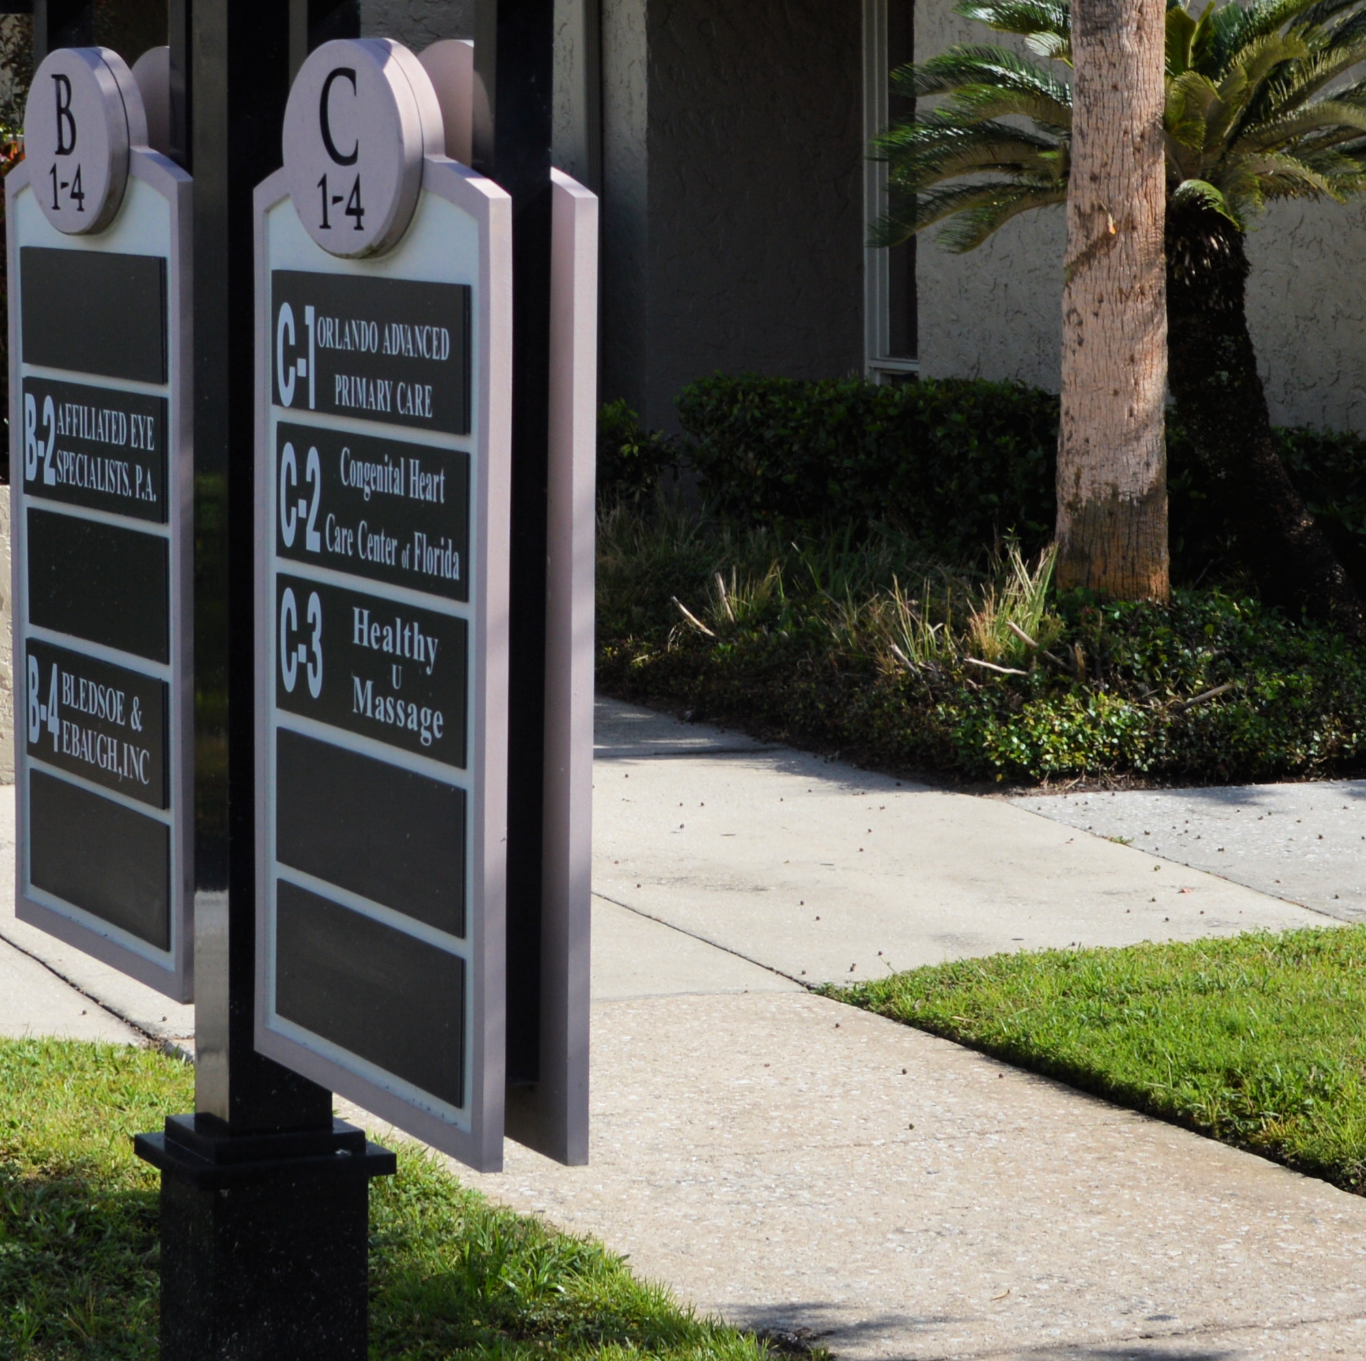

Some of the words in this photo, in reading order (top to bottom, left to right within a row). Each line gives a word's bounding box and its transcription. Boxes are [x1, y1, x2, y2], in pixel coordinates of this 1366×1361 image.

[51, 74, 77, 156] B
[320, 67, 359, 167] C
[48, 163, 85, 212] 1-4
[317, 173, 365, 231] 1-4
[277, 302, 315, 410] C-1
[317, 316, 378, 353] ORLANDO
[383, 323, 450, 360] ADVANCED
[56, 403, 127, 446] AFFILIATED
[130, 413, 155, 451] EYE
[334, 374, 393, 412] PRIMARY
[397, 382, 433, 418] CARE
[25, 392, 56, 486] B-2
[135, 464, 157, 502] P.A.
[280, 441, 321, 553] C-2
[340, 447, 404, 501] Congenital
[409, 458, 445, 504] Heart
[325, 513, 354, 556] Care
[357, 520, 398, 566] Center
[401, 543, 411, 569] of
[413, 531, 460, 581] Florida
[280, 587, 323, 699] C-3
[352, 606, 438, 675] Healthy
[28, 654, 60, 753] B-4
[61, 671, 125, 726] BLEDSOE
[130, 696, 142, 732] &
[352, 675, 443, 746] Massage
[391, 664, 402, 690] U
